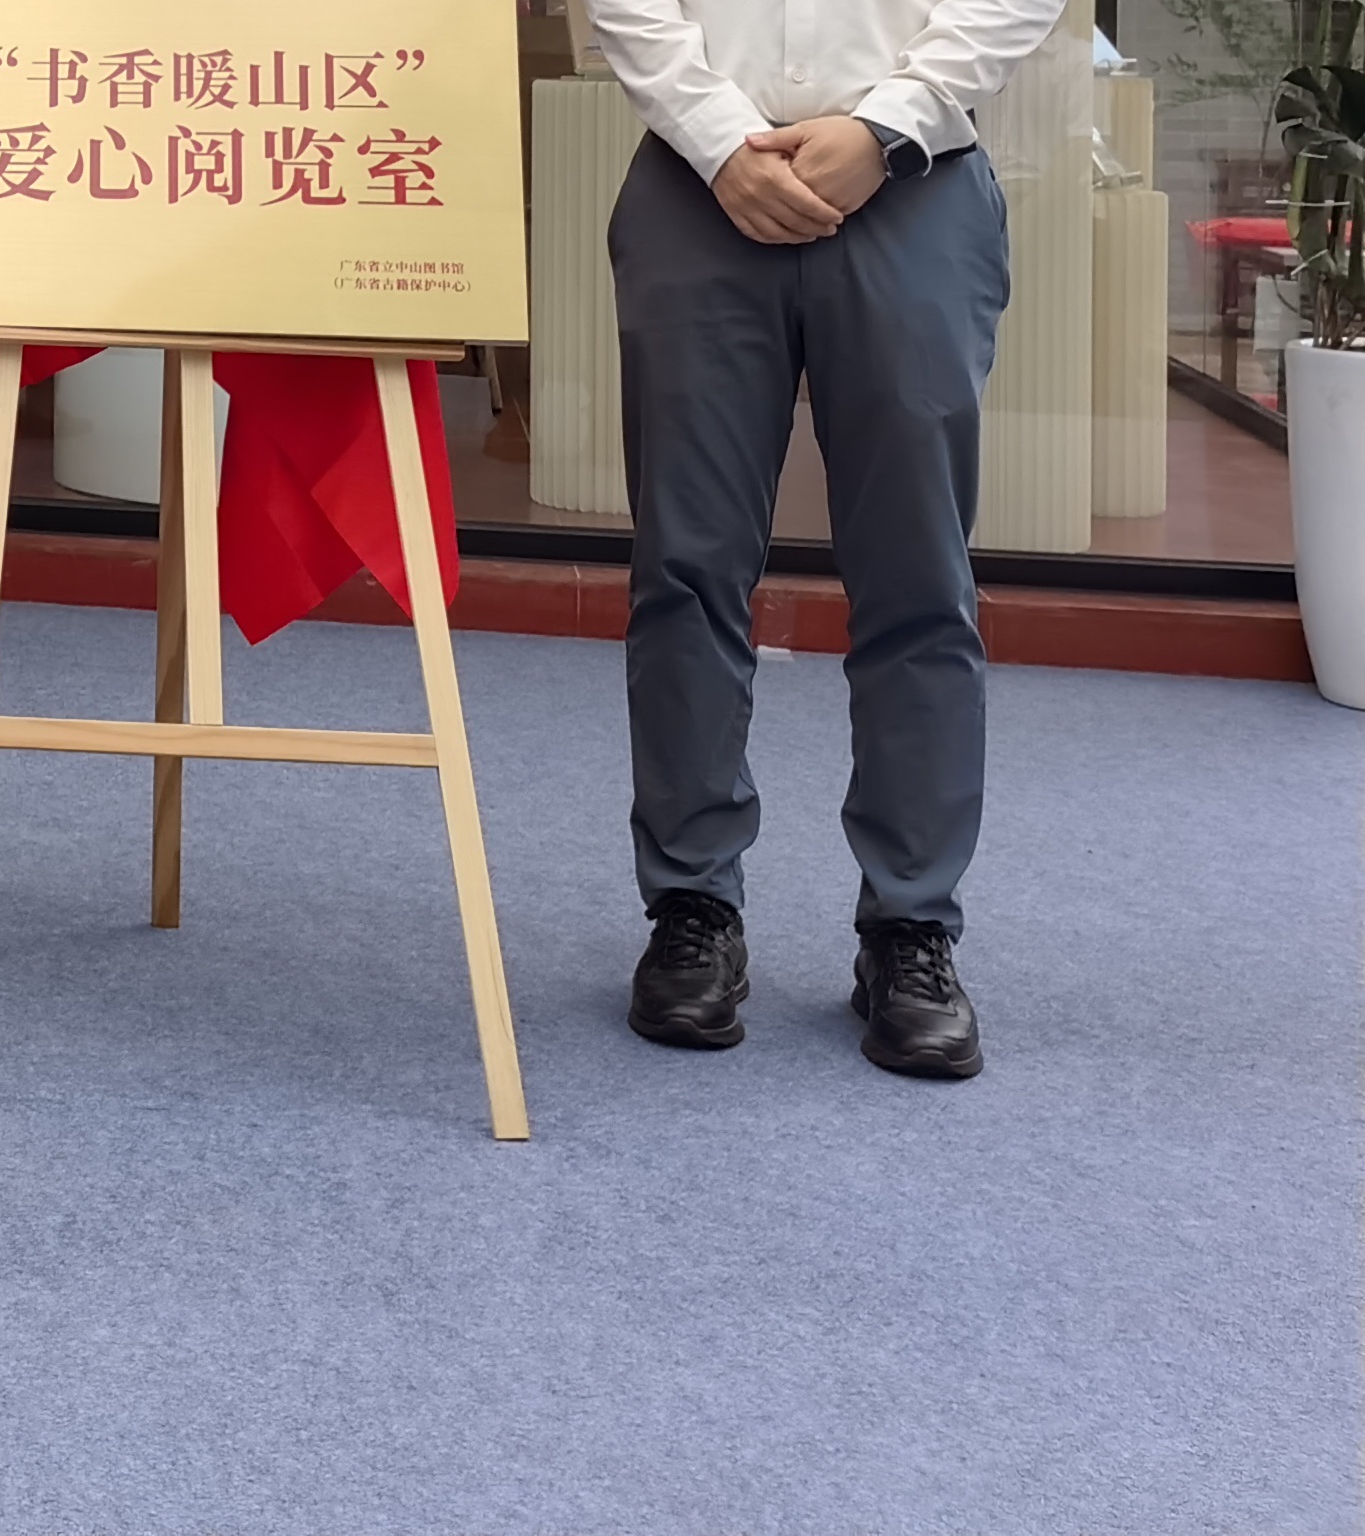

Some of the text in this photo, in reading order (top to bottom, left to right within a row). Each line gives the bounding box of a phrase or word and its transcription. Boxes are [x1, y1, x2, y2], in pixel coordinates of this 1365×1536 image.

[339, 259, 465, 275] 广东省立中山图书馆
